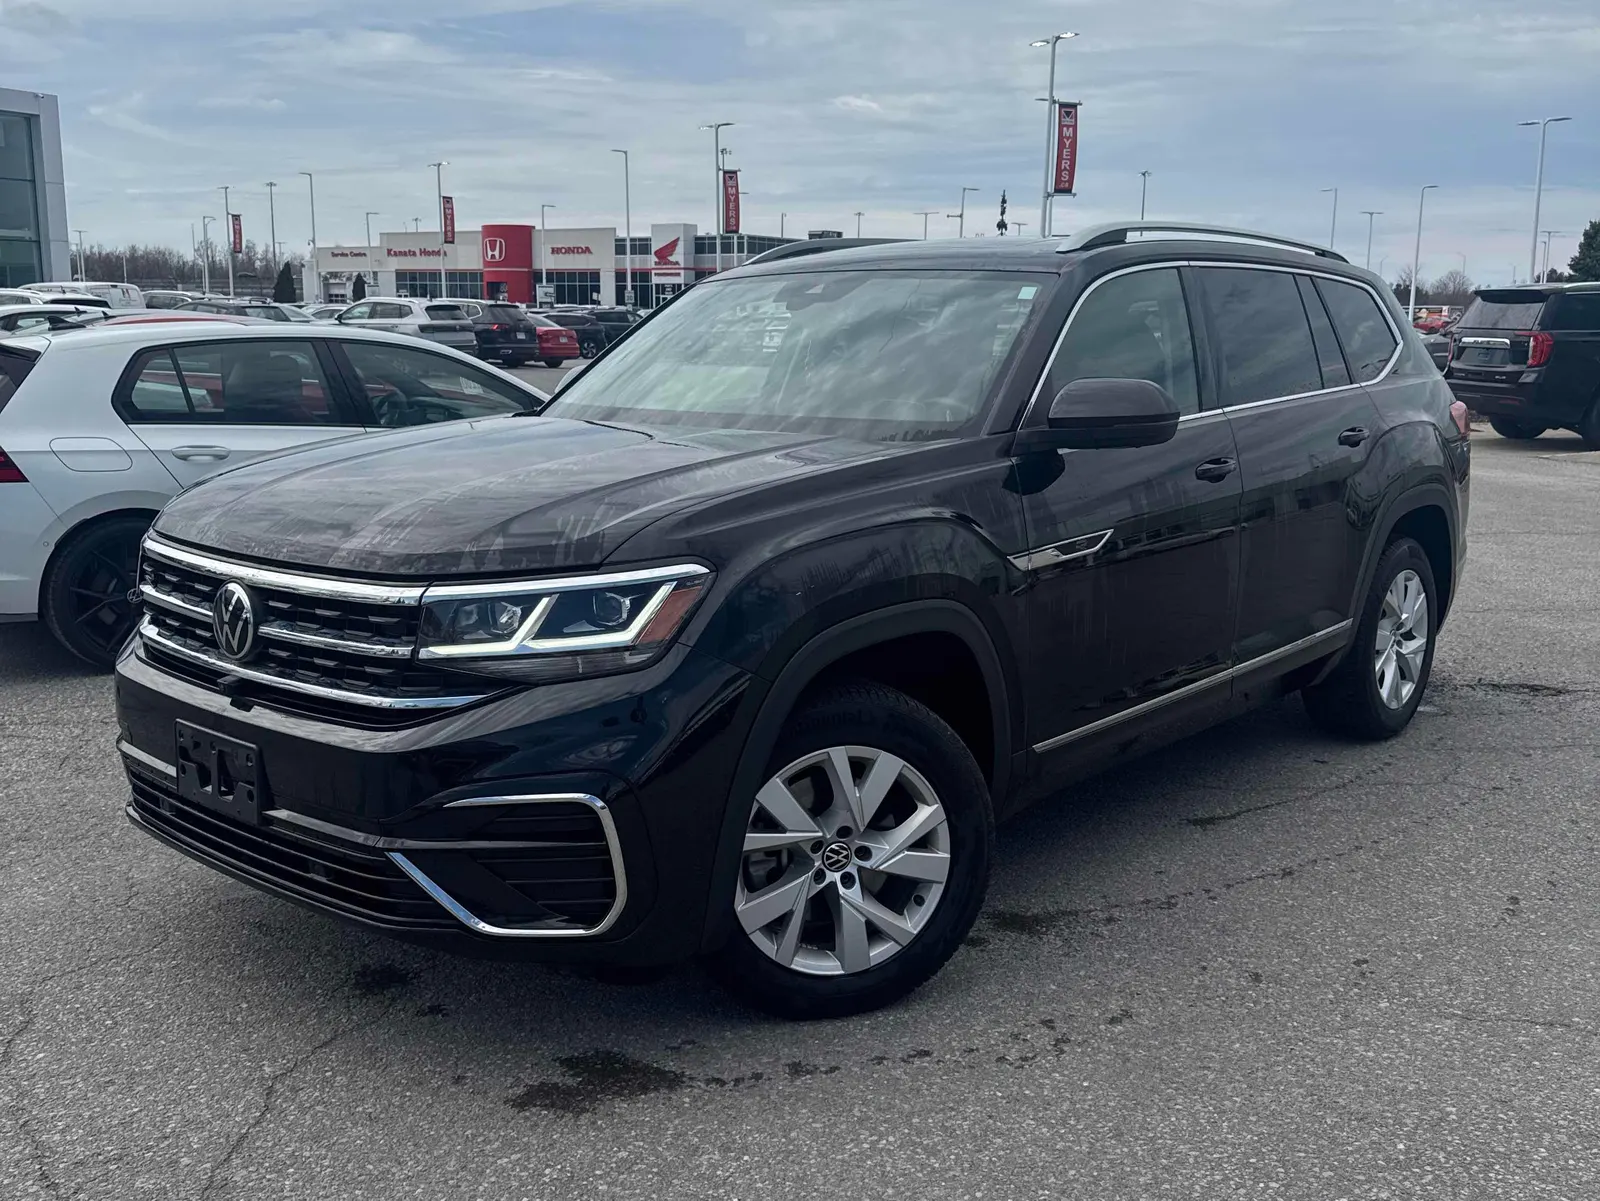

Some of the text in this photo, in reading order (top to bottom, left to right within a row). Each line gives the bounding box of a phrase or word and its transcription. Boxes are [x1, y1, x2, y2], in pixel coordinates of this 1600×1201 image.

[1061, 127, 1073, 181] MYERS
[728, 187, 736, 225] MYERS
[387, 248, 417, 257] Kanata
[551, 246, 592, 255] HONDA
